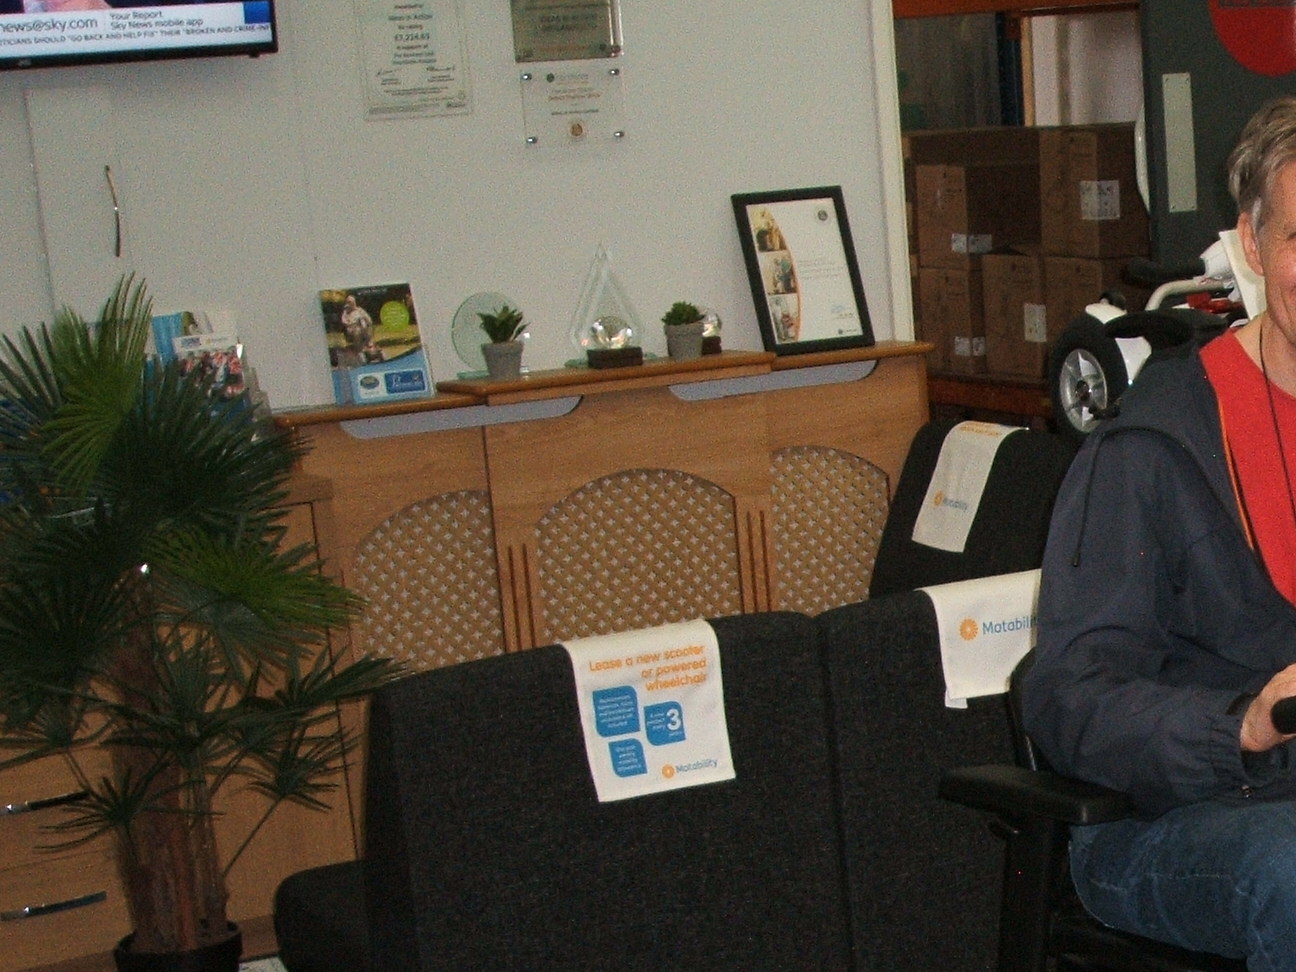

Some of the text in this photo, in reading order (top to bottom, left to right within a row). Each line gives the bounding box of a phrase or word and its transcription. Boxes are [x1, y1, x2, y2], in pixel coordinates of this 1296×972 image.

[132, 11, 162, 19] Report
[0, 19, 98, 33] news@sky.com
[111, 19, 204, 31] Sky News mobile app
[34, 35, 66, 44] SHOULD
[589, 644, 706, 673] Lease a new scooter
[641, 658, 708, 679] or powered
[645, 672, 709, 692] wheelchair
[666, 708, 682, 731] 3
[676, 757, 718, 774] Motability
